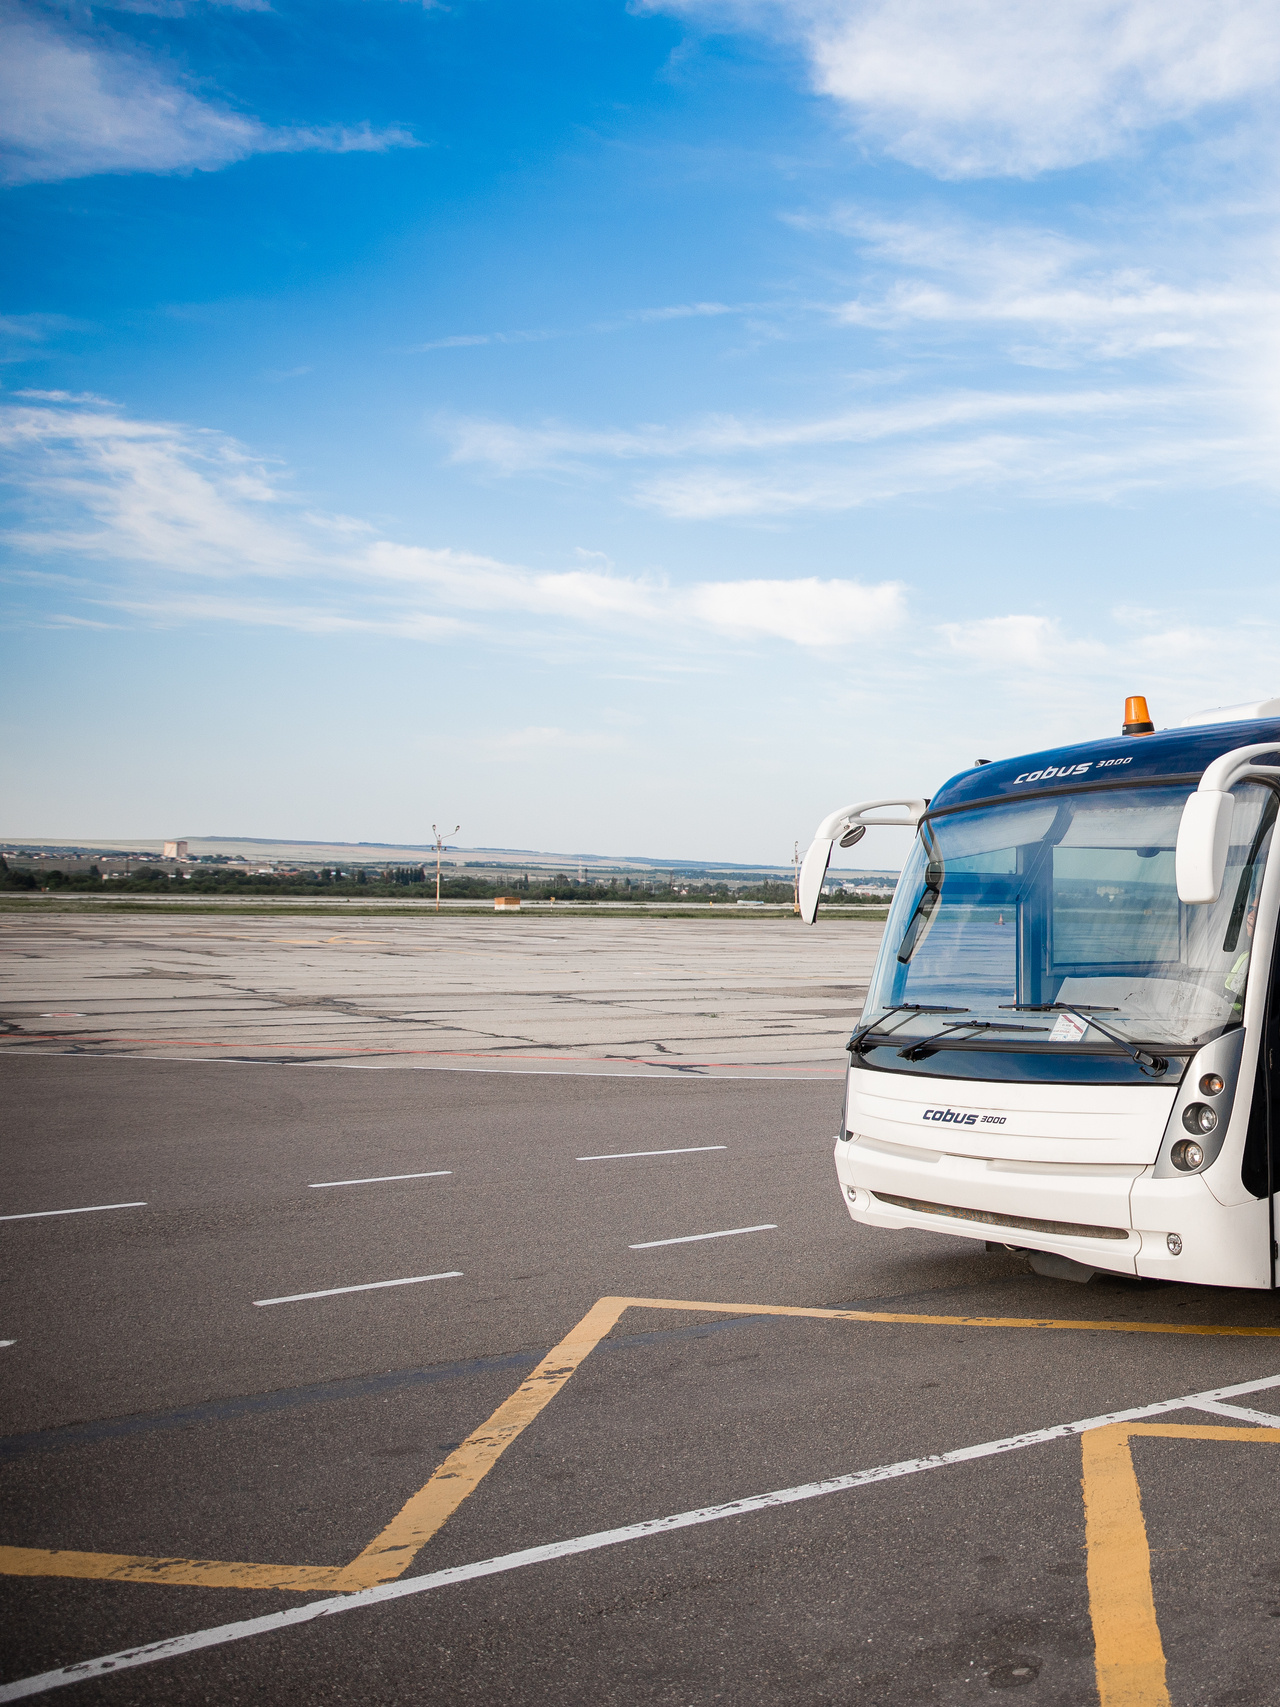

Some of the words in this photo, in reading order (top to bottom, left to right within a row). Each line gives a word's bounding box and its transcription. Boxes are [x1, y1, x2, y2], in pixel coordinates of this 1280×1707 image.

[1013, 762, 1093, 785] cobus
[1096, 757, 1133, 768] 3000
[922, 1109, 979, 1125] cobus
[980, 1115, 1007, 1124] 3000
